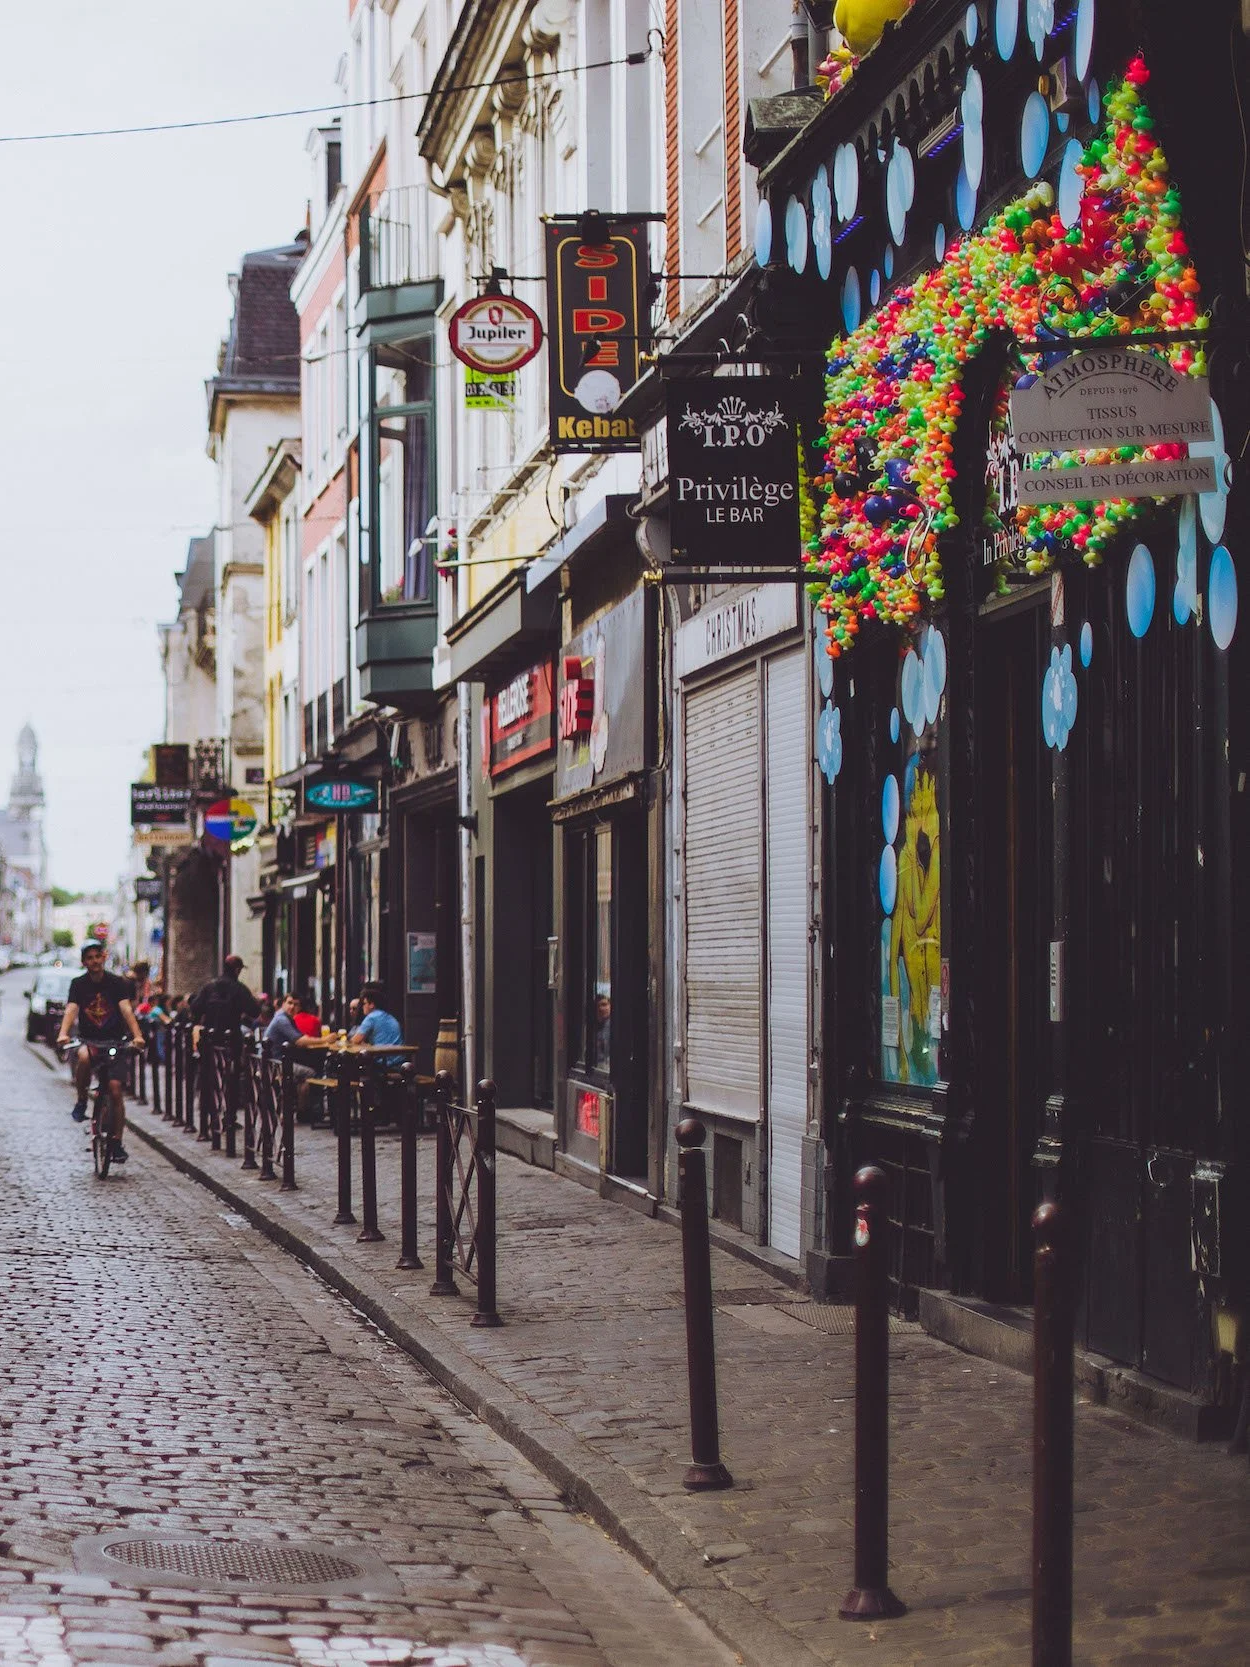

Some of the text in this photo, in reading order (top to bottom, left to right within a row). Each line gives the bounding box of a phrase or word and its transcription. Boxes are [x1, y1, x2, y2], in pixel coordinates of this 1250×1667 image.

[574, 243, 626, 366] SIDE
[469, 326, 526, 342] Jupiler
[1080, 387, 1116, 396] DEPUIS
[1087, 405, 1137, 420] TISSUS
[703, 424, 765, 447] I.P.O
[1018, 420, 1210, 444] CONFECTION SUR MESURE
[677, 476, 794, 506] Privilège
[1024, 467, 1211, 492] CONSEIL EN DÉCORATION
[706, 507, 764, 522] LE BAR
[706, 597, 756, 656] CHRISTMAS
